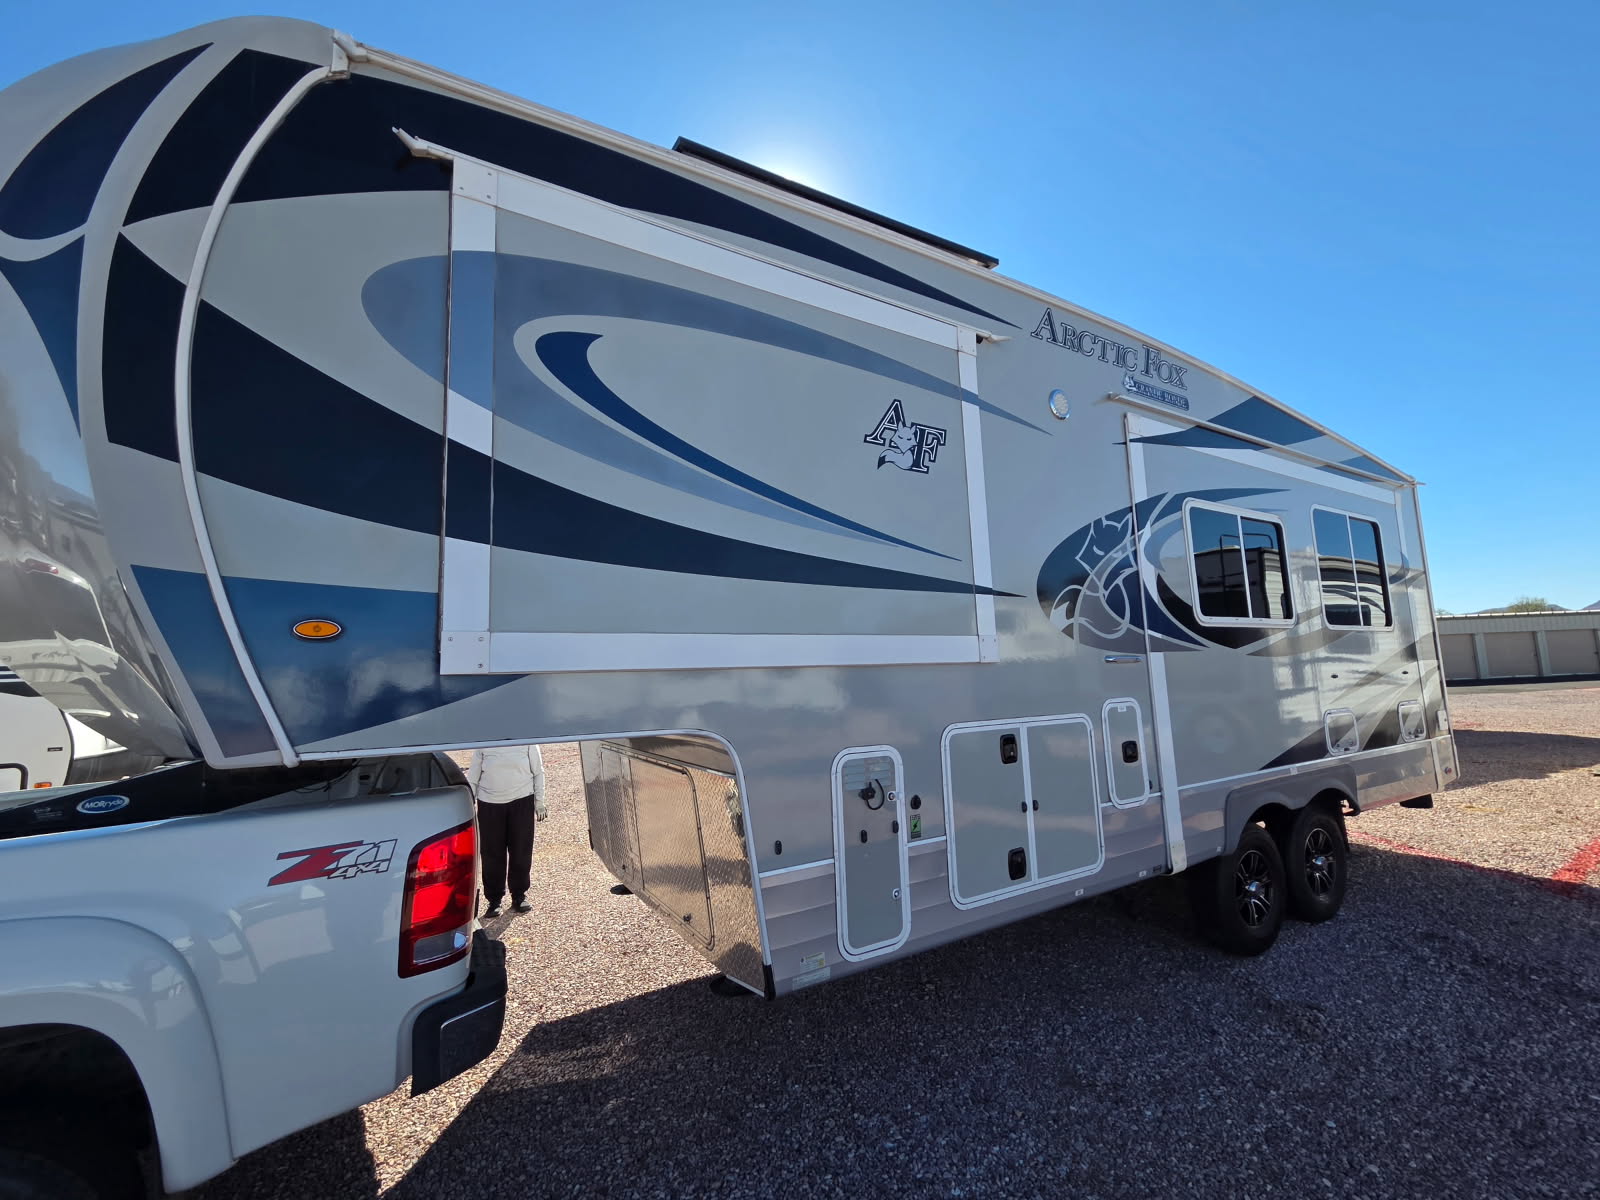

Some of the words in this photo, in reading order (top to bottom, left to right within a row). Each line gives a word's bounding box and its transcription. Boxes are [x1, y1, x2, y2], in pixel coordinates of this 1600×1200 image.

[1030, 307, 1138, 372] ARCTIC
[1141, 344, 1188, 390] FOX
[267, 838, 398, 887] Z71
